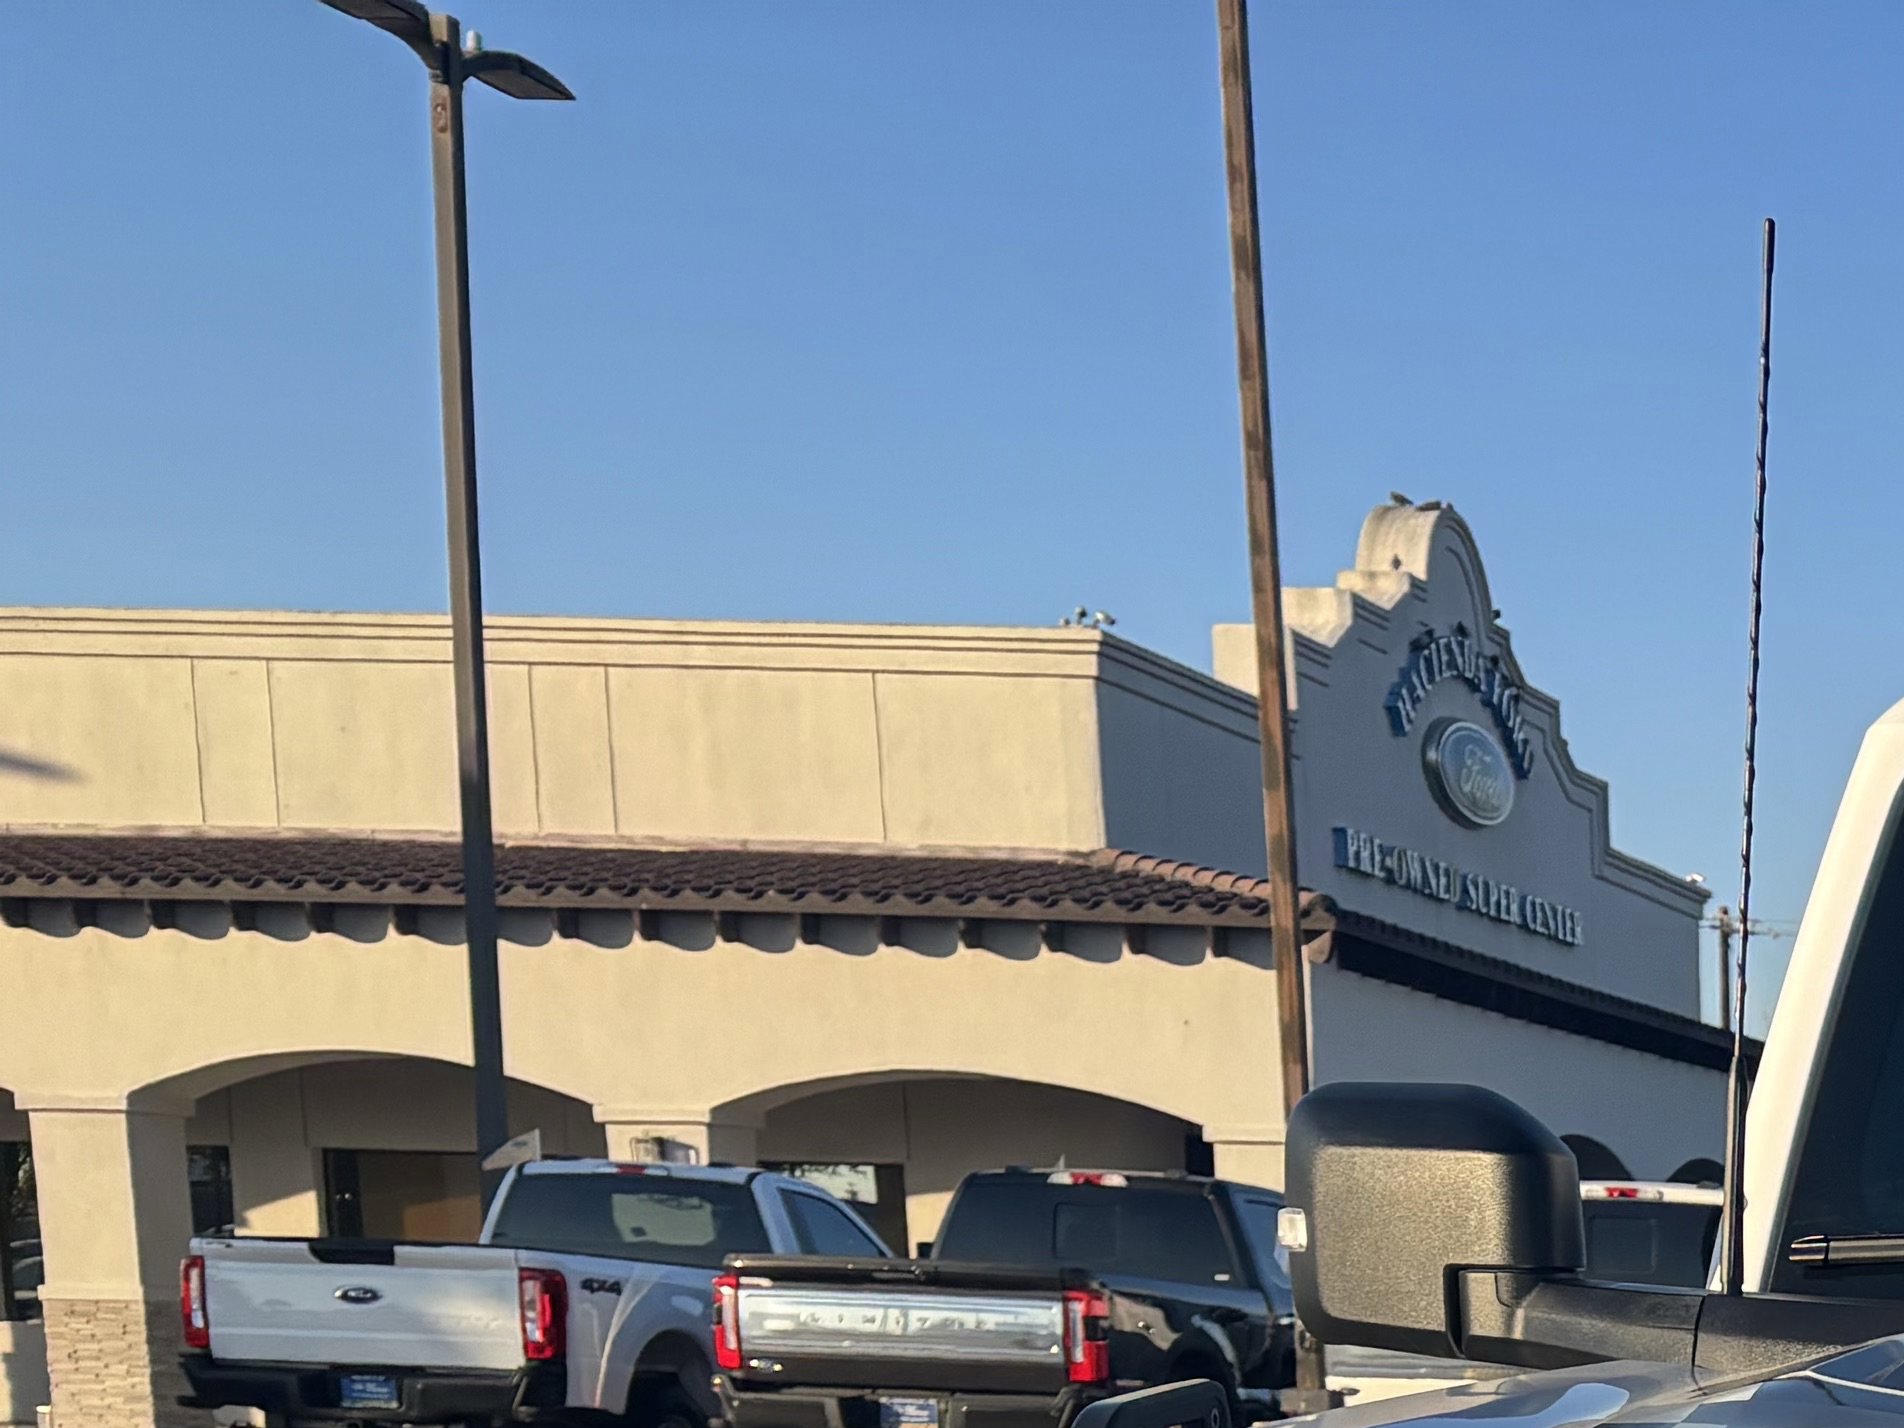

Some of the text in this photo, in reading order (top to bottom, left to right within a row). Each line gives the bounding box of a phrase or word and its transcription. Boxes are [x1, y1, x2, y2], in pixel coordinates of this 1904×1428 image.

[1340, 827, 1585, 946] PRE-OWNED SUPER CENTER
